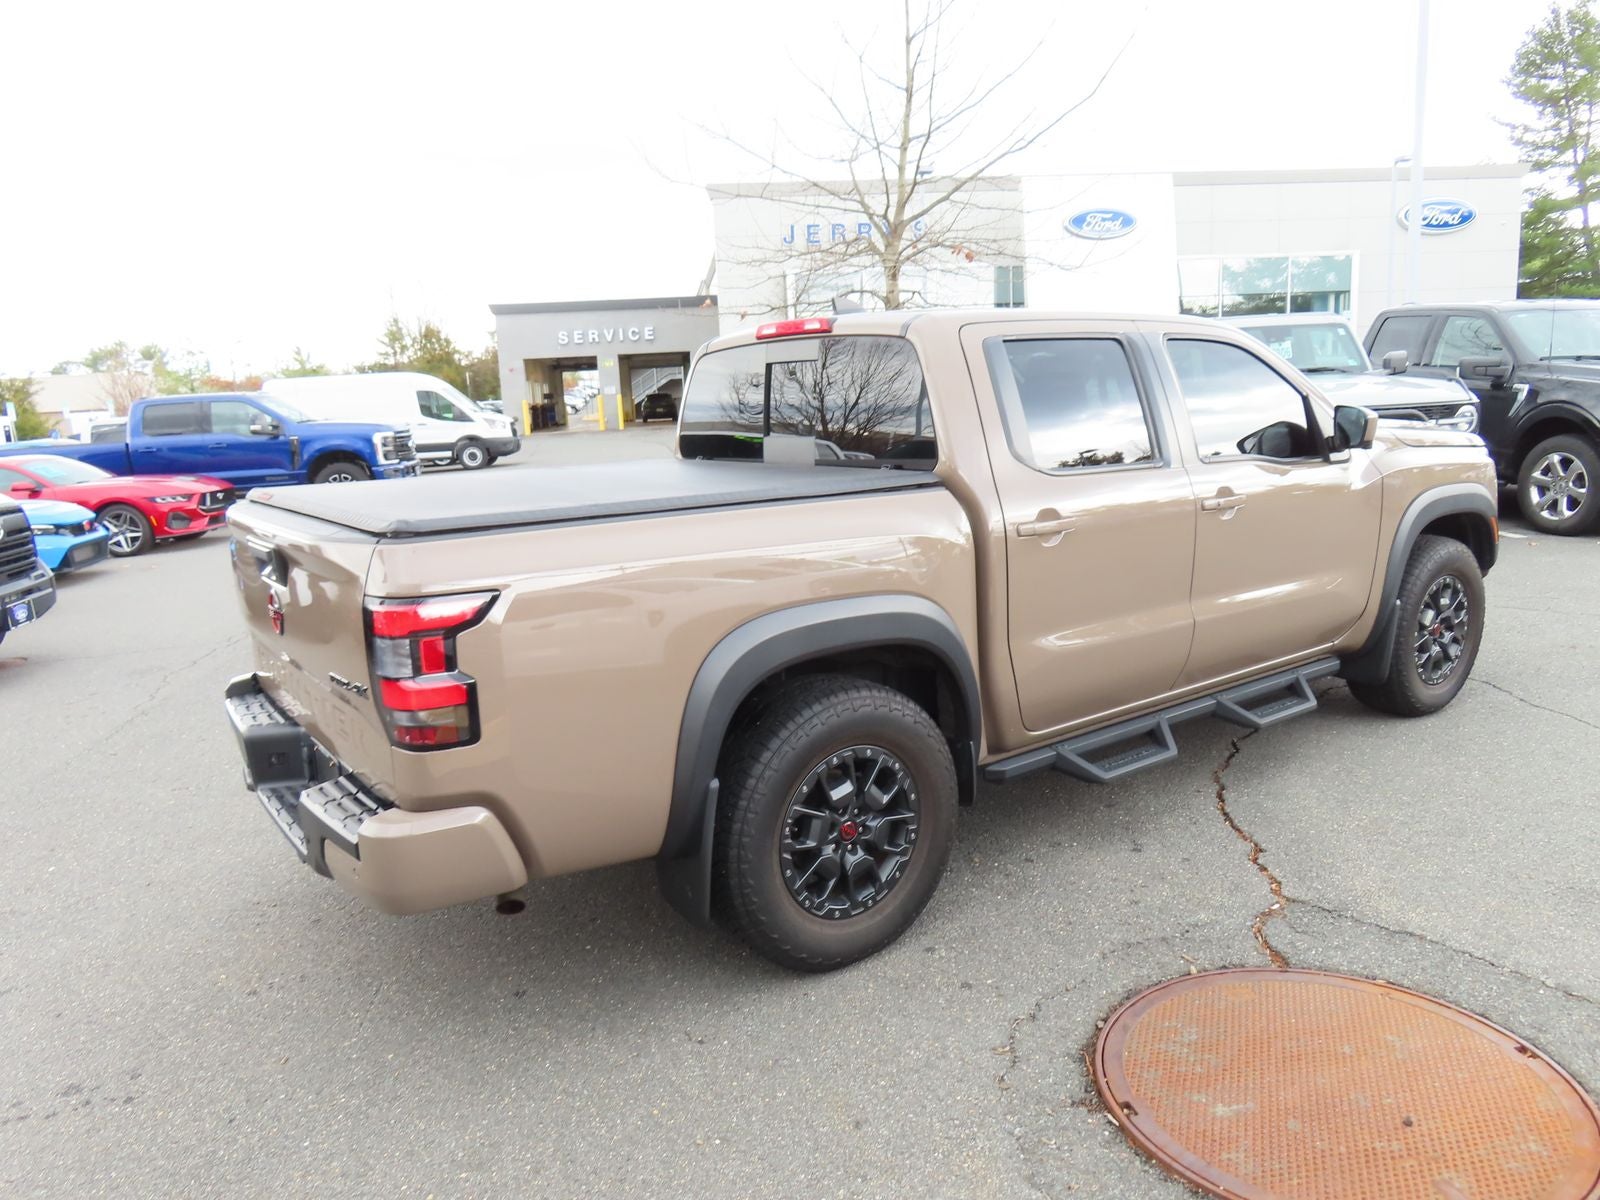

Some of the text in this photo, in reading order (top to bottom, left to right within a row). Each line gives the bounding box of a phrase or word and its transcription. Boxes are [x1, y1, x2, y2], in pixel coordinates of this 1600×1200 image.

[1082, 212, 1124, 231] Ford
[1421, 205, 1464, 225] Ford
[558, 326, 655, 345] SERVICE
